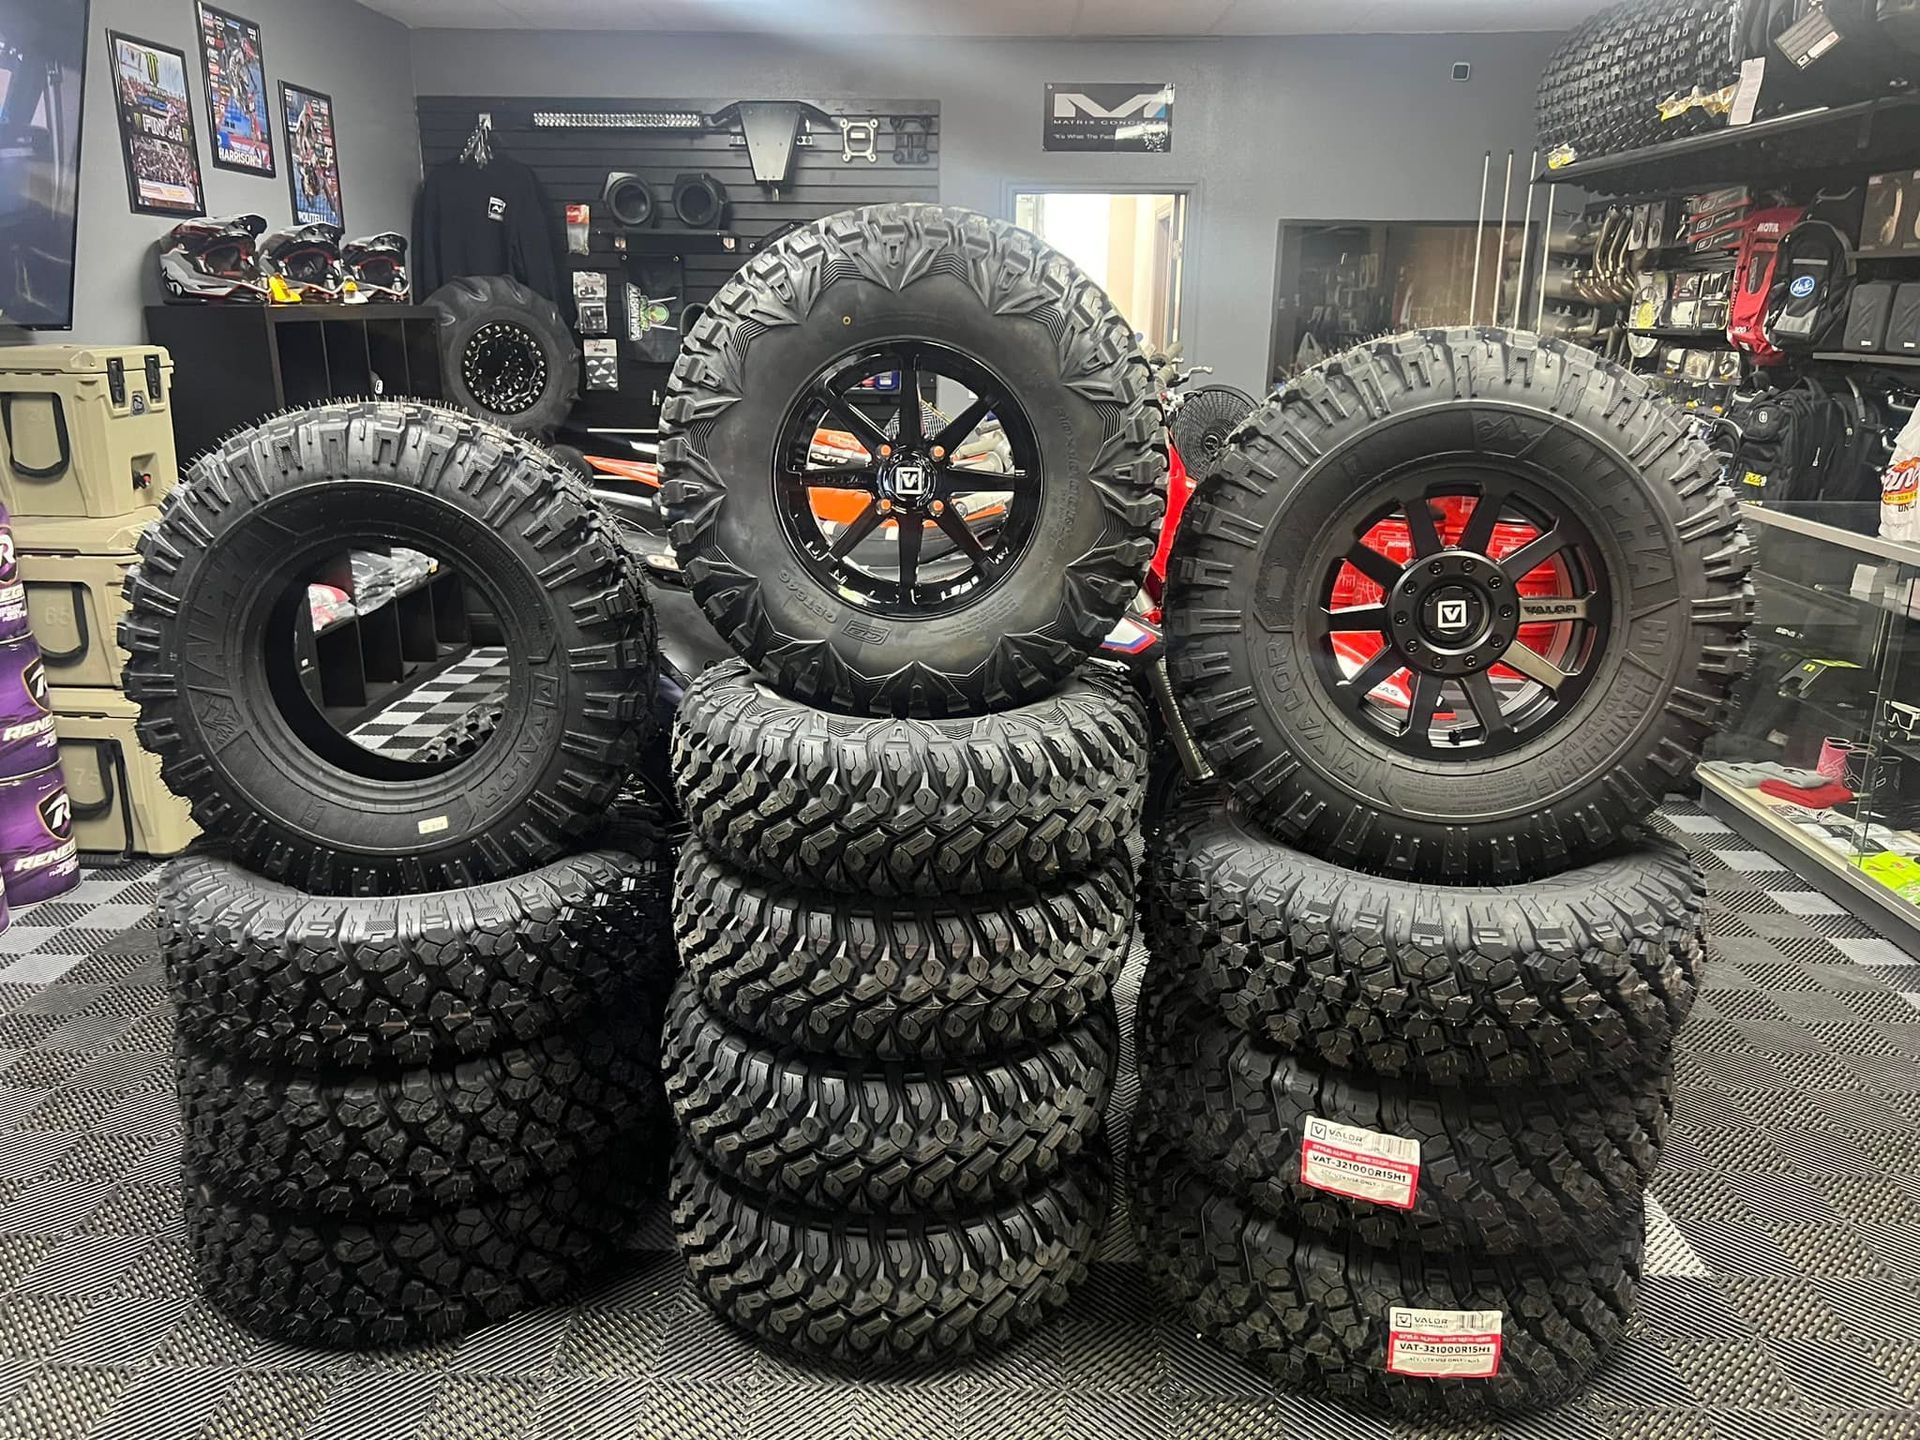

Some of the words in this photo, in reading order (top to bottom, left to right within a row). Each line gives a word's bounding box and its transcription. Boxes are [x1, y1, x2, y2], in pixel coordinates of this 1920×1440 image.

[218, 149, 258, 167] HARRISON
[1523, 605, 1578, 615] VALOR
[1264, 637, 1330, 757] VALOR
[480, 717, 549, 808] VALOR
[1329, 1129, 1363, 1143] VALOR
[1312, 1153, 1407, 1183] VAT-321000R15H1
[1414, 1316, 1449, 1325] VALOR
[1399, 1342, 1491, 1354] VAT-321000R15H1
